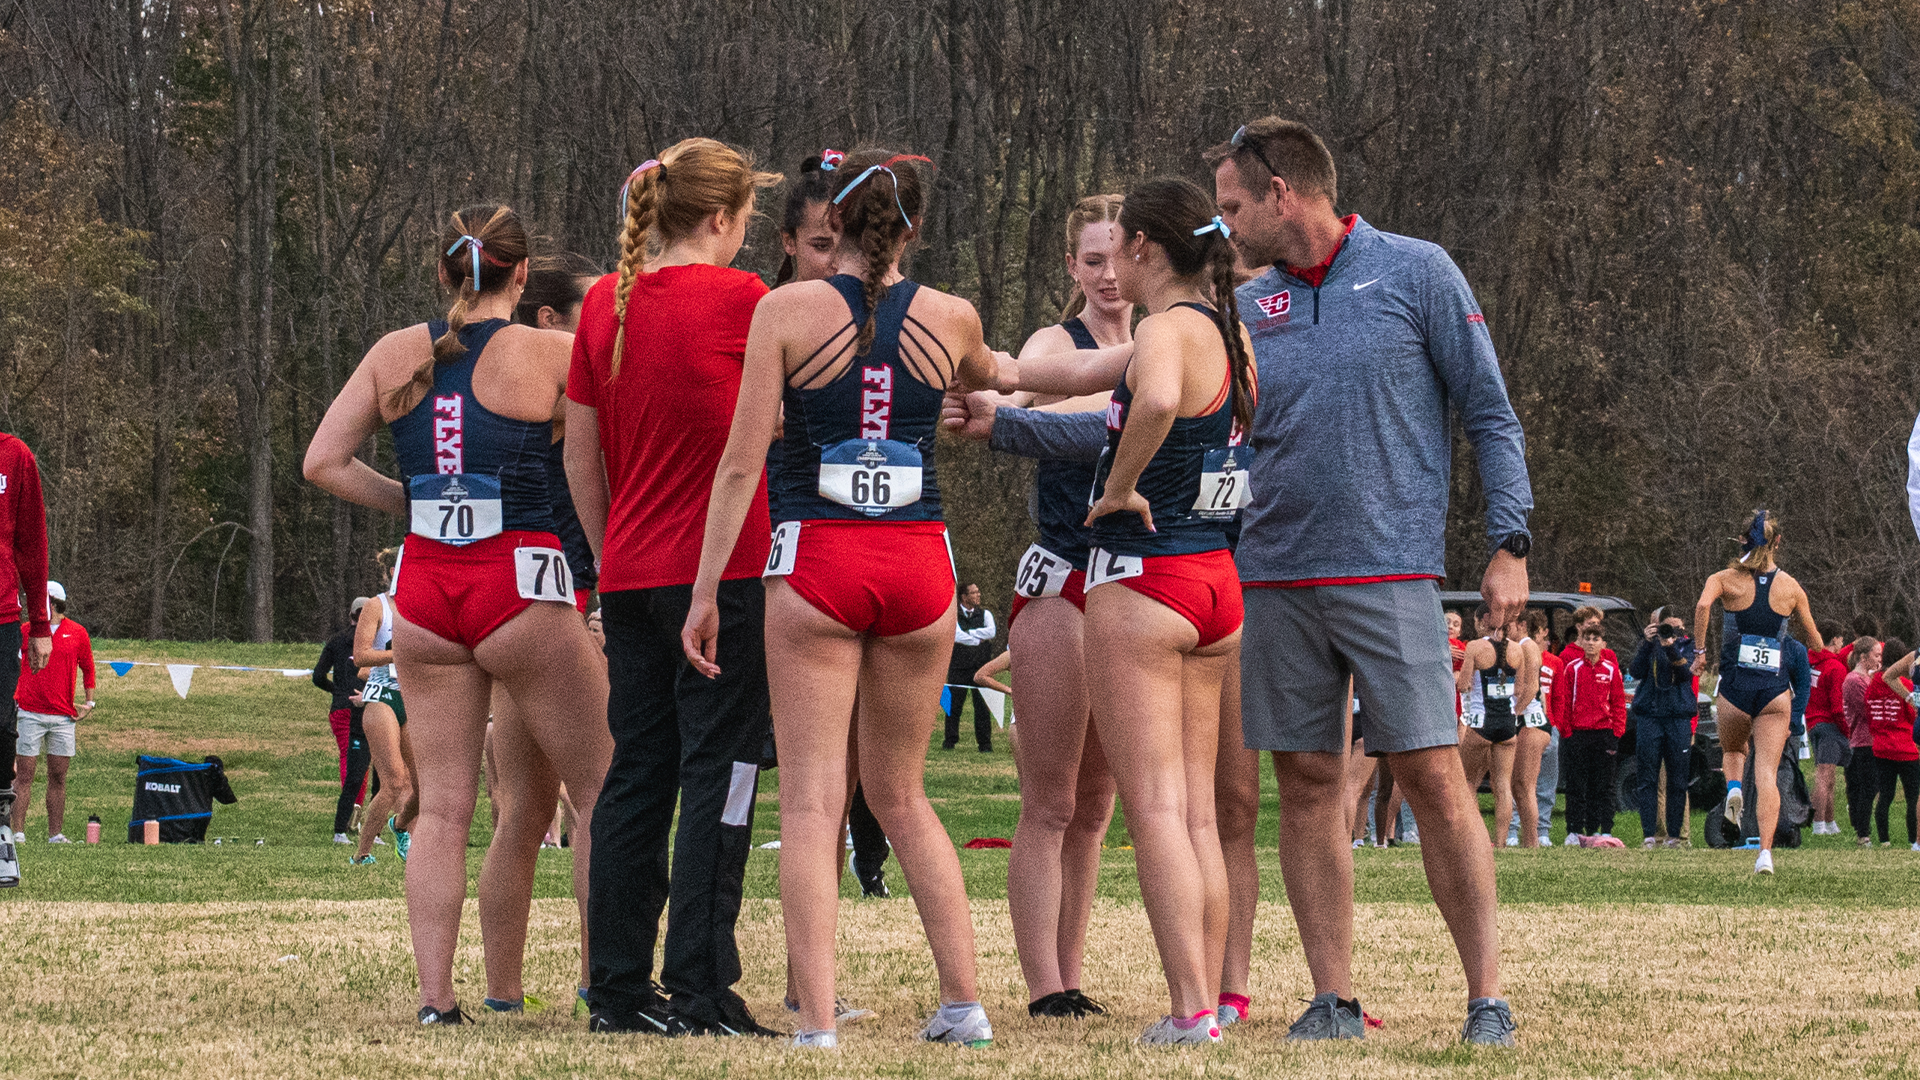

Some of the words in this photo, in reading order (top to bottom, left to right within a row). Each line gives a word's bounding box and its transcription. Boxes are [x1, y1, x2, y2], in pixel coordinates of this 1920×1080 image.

[852, 470, 891, 505] 66
[1210, 476, 1236, 508] 72
[438, 504, 474, 537] 70
[532, 553, 567, 597] 70
[1018, 551, 1057, 597] 65
[1752, 649, 1770, 665] 35
[363, 683, 380, 700] 72
[1530, 712, 1543, 725] 49
[145, 781, 181, 793] KOBALT
